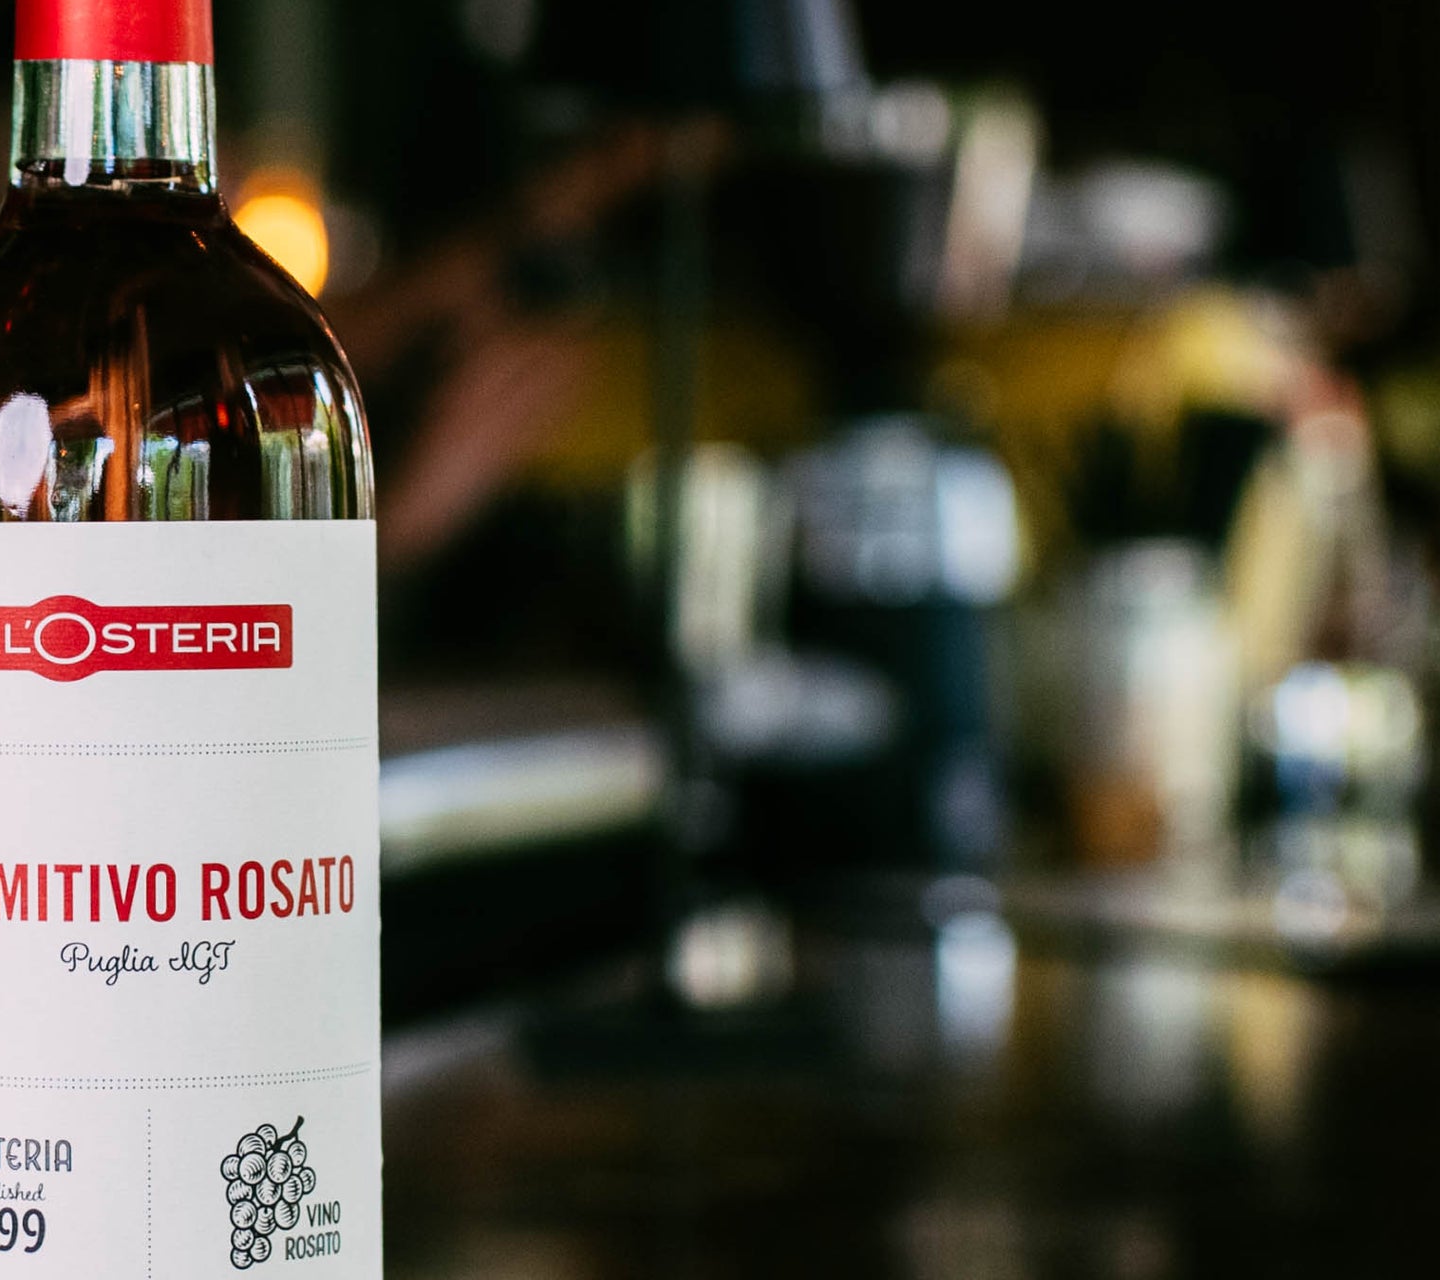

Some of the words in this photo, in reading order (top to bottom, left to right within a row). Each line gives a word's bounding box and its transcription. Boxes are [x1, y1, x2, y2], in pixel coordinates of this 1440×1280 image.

[4, 612, 280, 665] L'OSTERIA
[201, 854, 355, 922] ROSATO
[60, 941, 160, 987] Puglia
[168, 939, 236, 986] IGT
[305, 1200, 341, 1228] VINO
[284, 1229, 341, 1261] ROSATO
